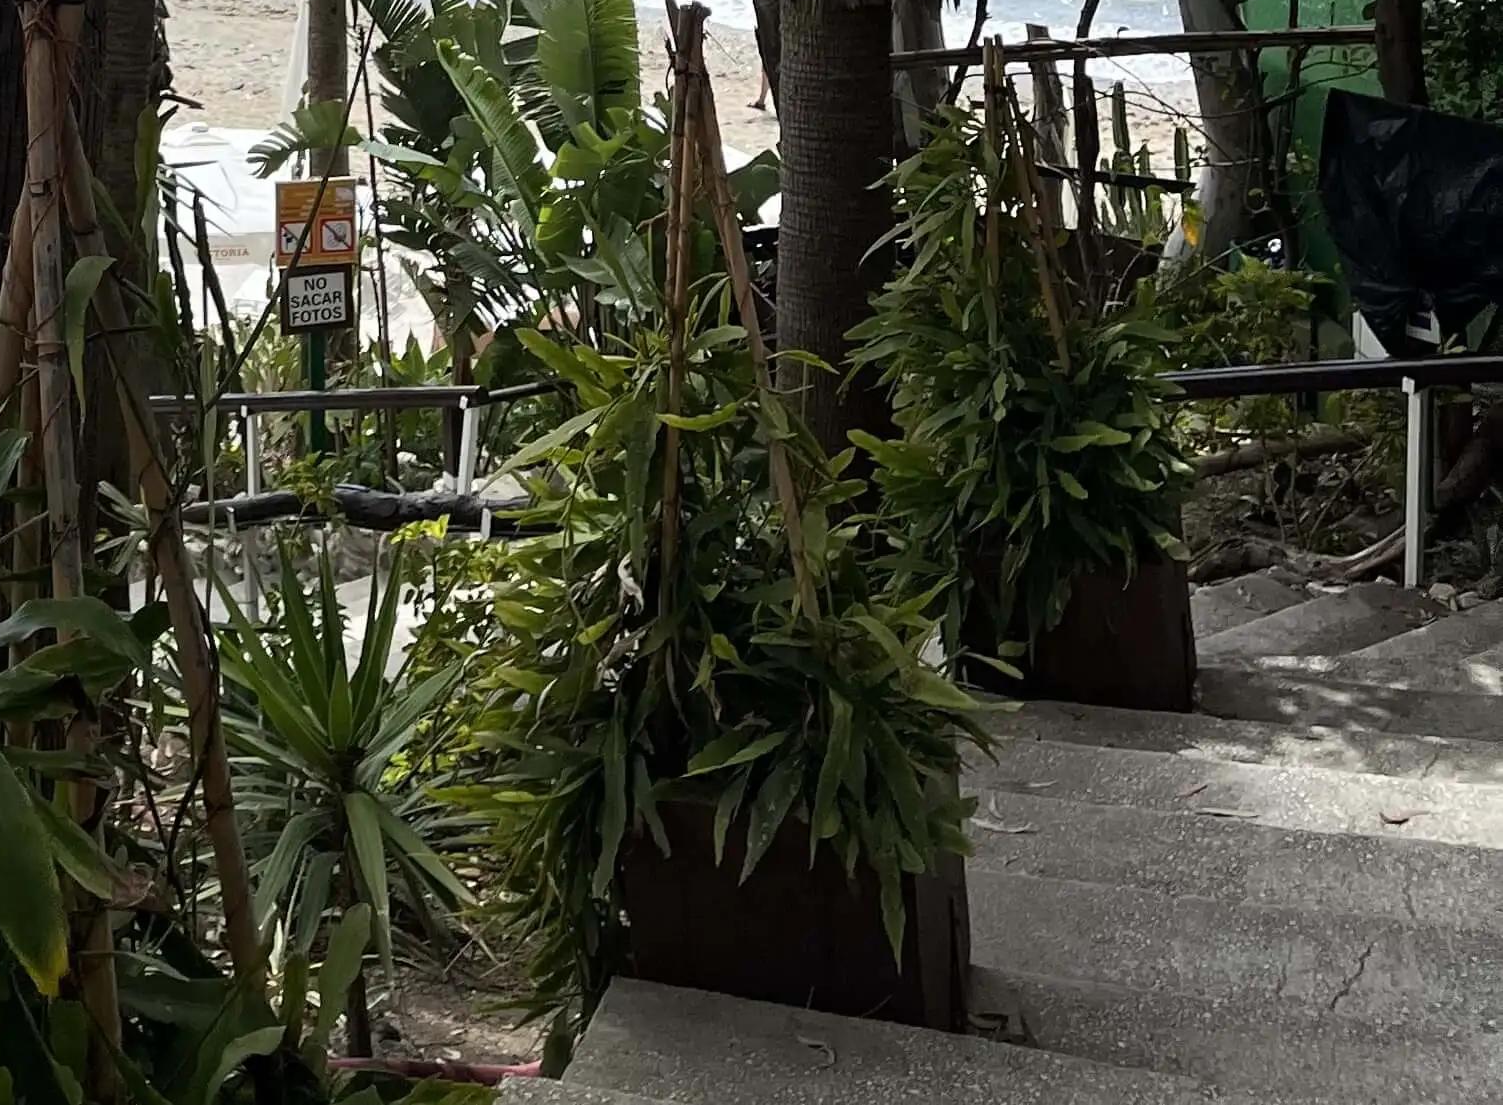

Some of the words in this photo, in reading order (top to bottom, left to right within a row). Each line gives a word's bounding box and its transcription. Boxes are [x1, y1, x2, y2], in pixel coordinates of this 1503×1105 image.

[194, 248, 250, 257] TORIA
[304, 277, 327, 291] NO
[290, 291, 342, 308] SACAR
[292, 306, 342, 324] FOTOS
